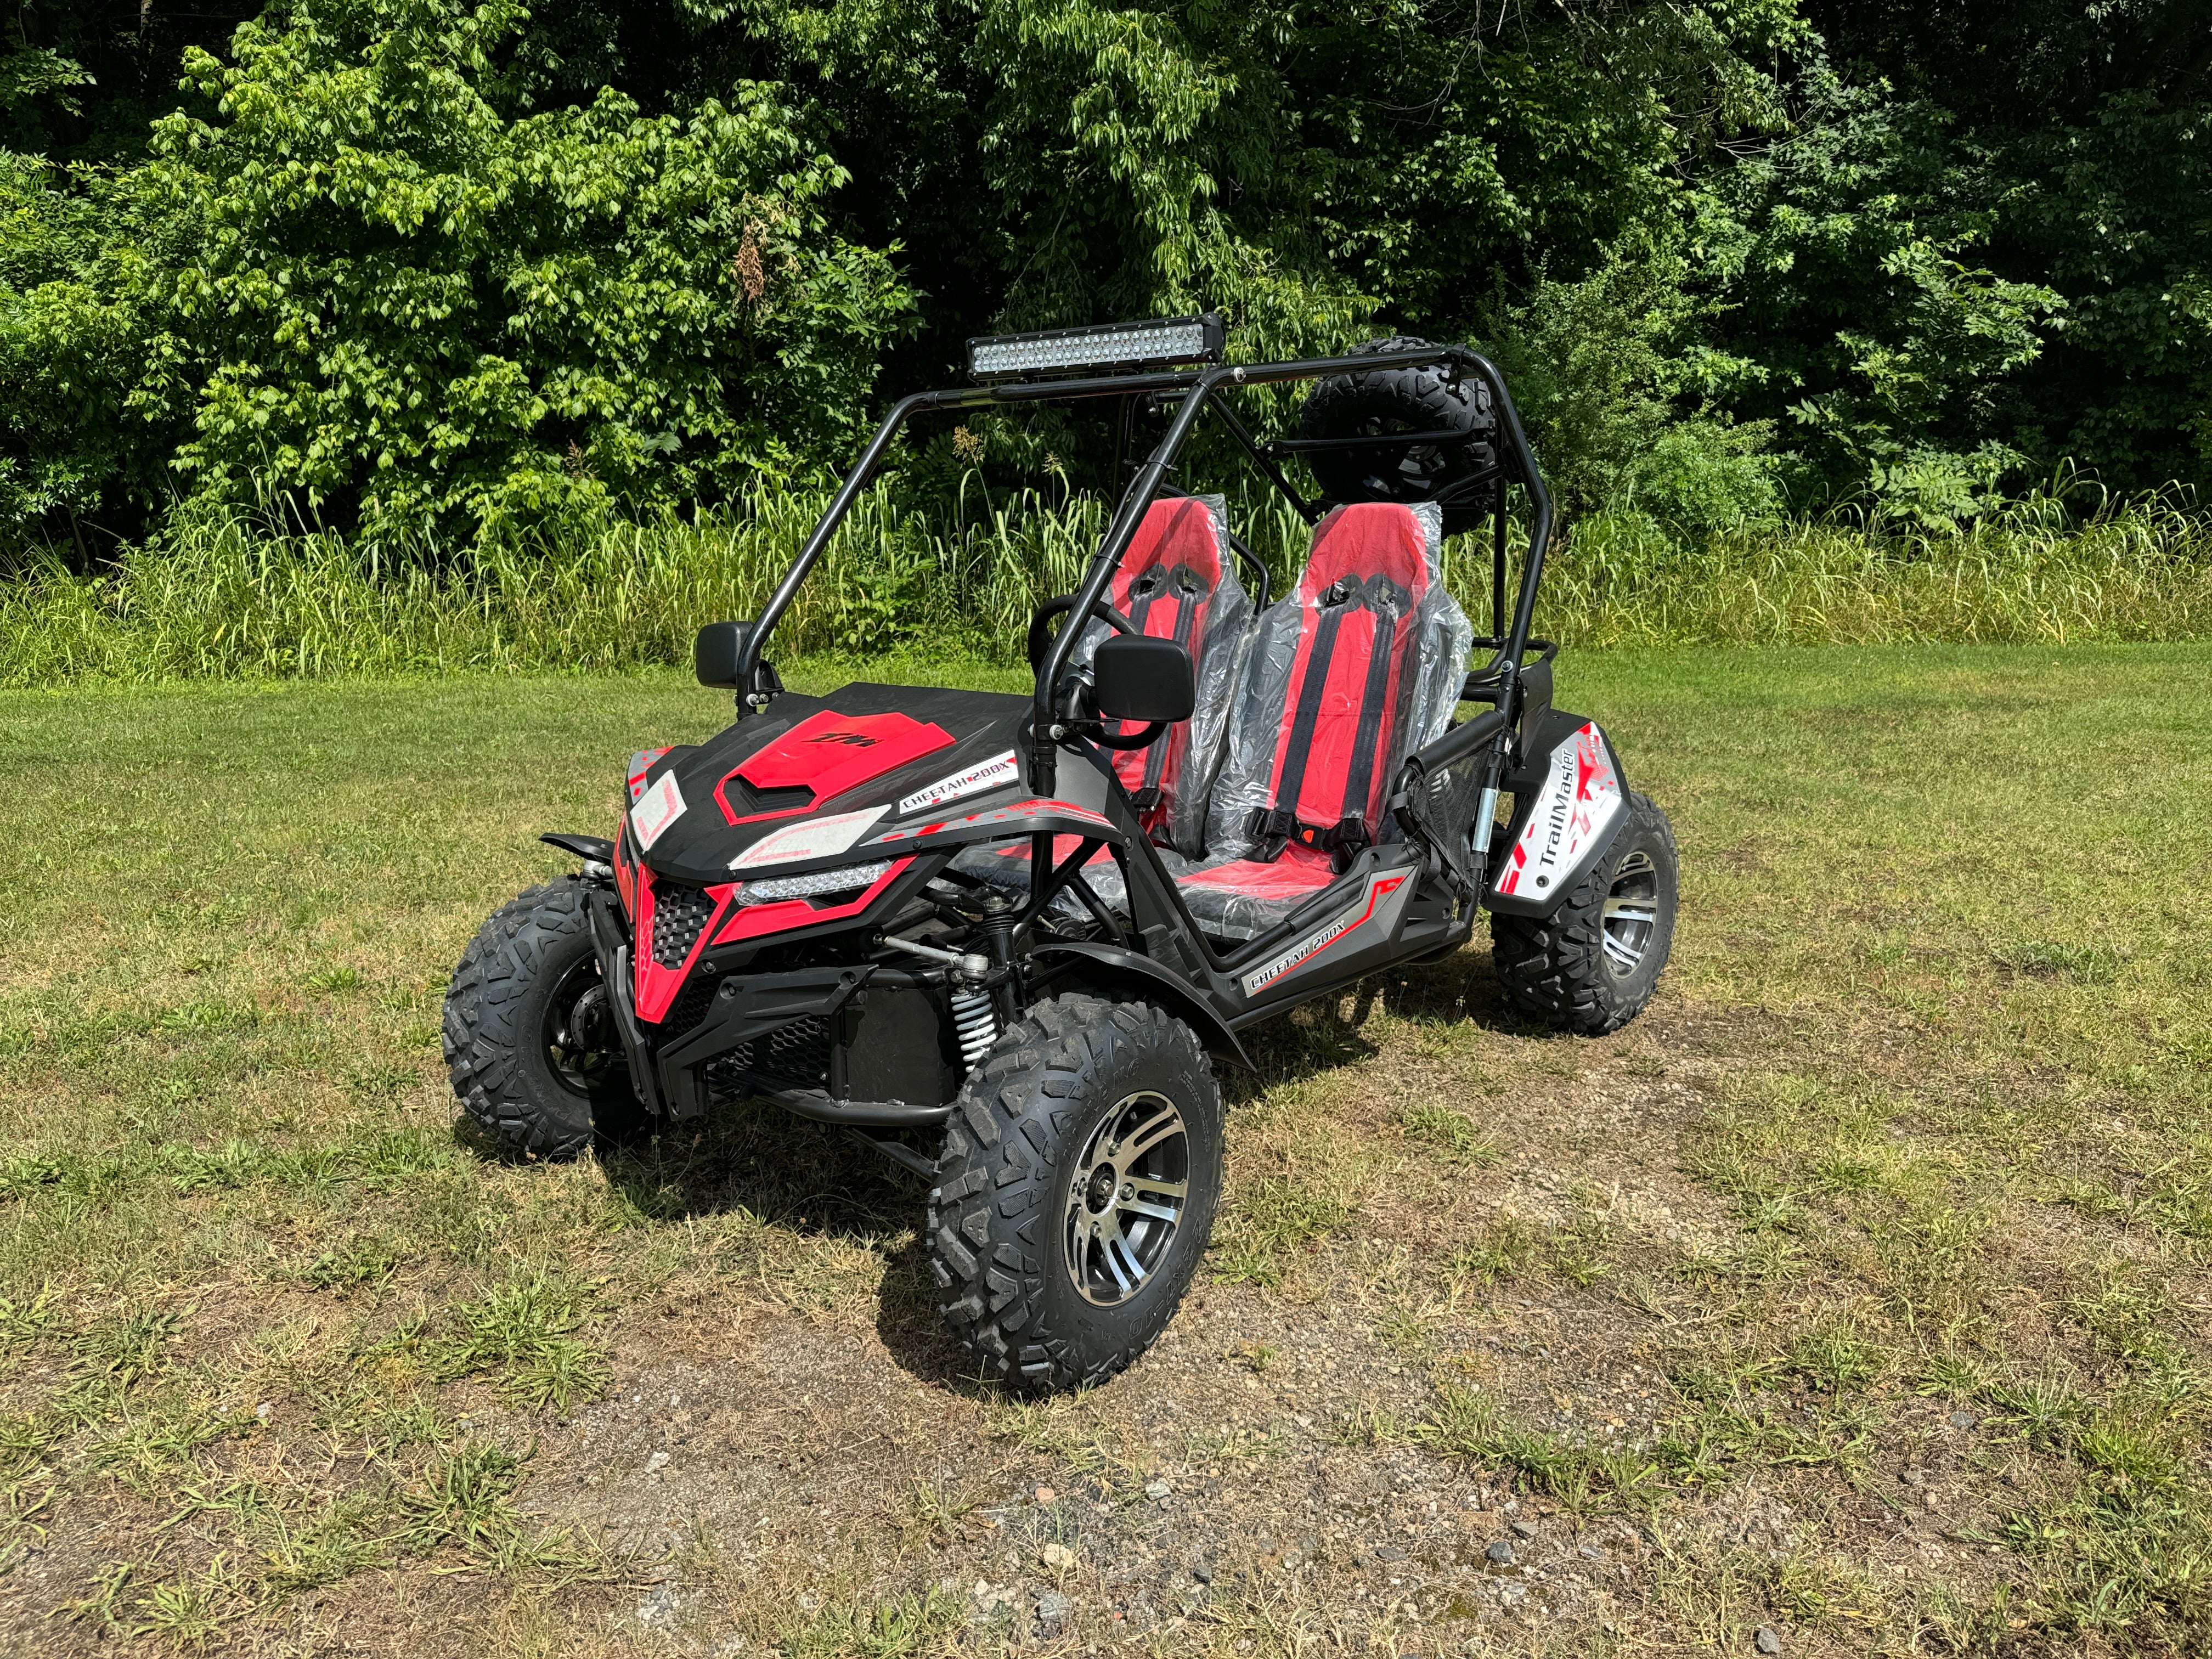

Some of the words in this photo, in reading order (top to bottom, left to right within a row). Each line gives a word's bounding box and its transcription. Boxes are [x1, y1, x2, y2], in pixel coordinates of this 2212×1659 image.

[903, 777, 968, 808] CHEETAH
[970, 761, 1010, 781] 200X
[1539, 748, 1574, 866] TrailMaster
[1251, 945, 1308, 989] CHEETAH
[1313, 921, 1345, 951] 200X
